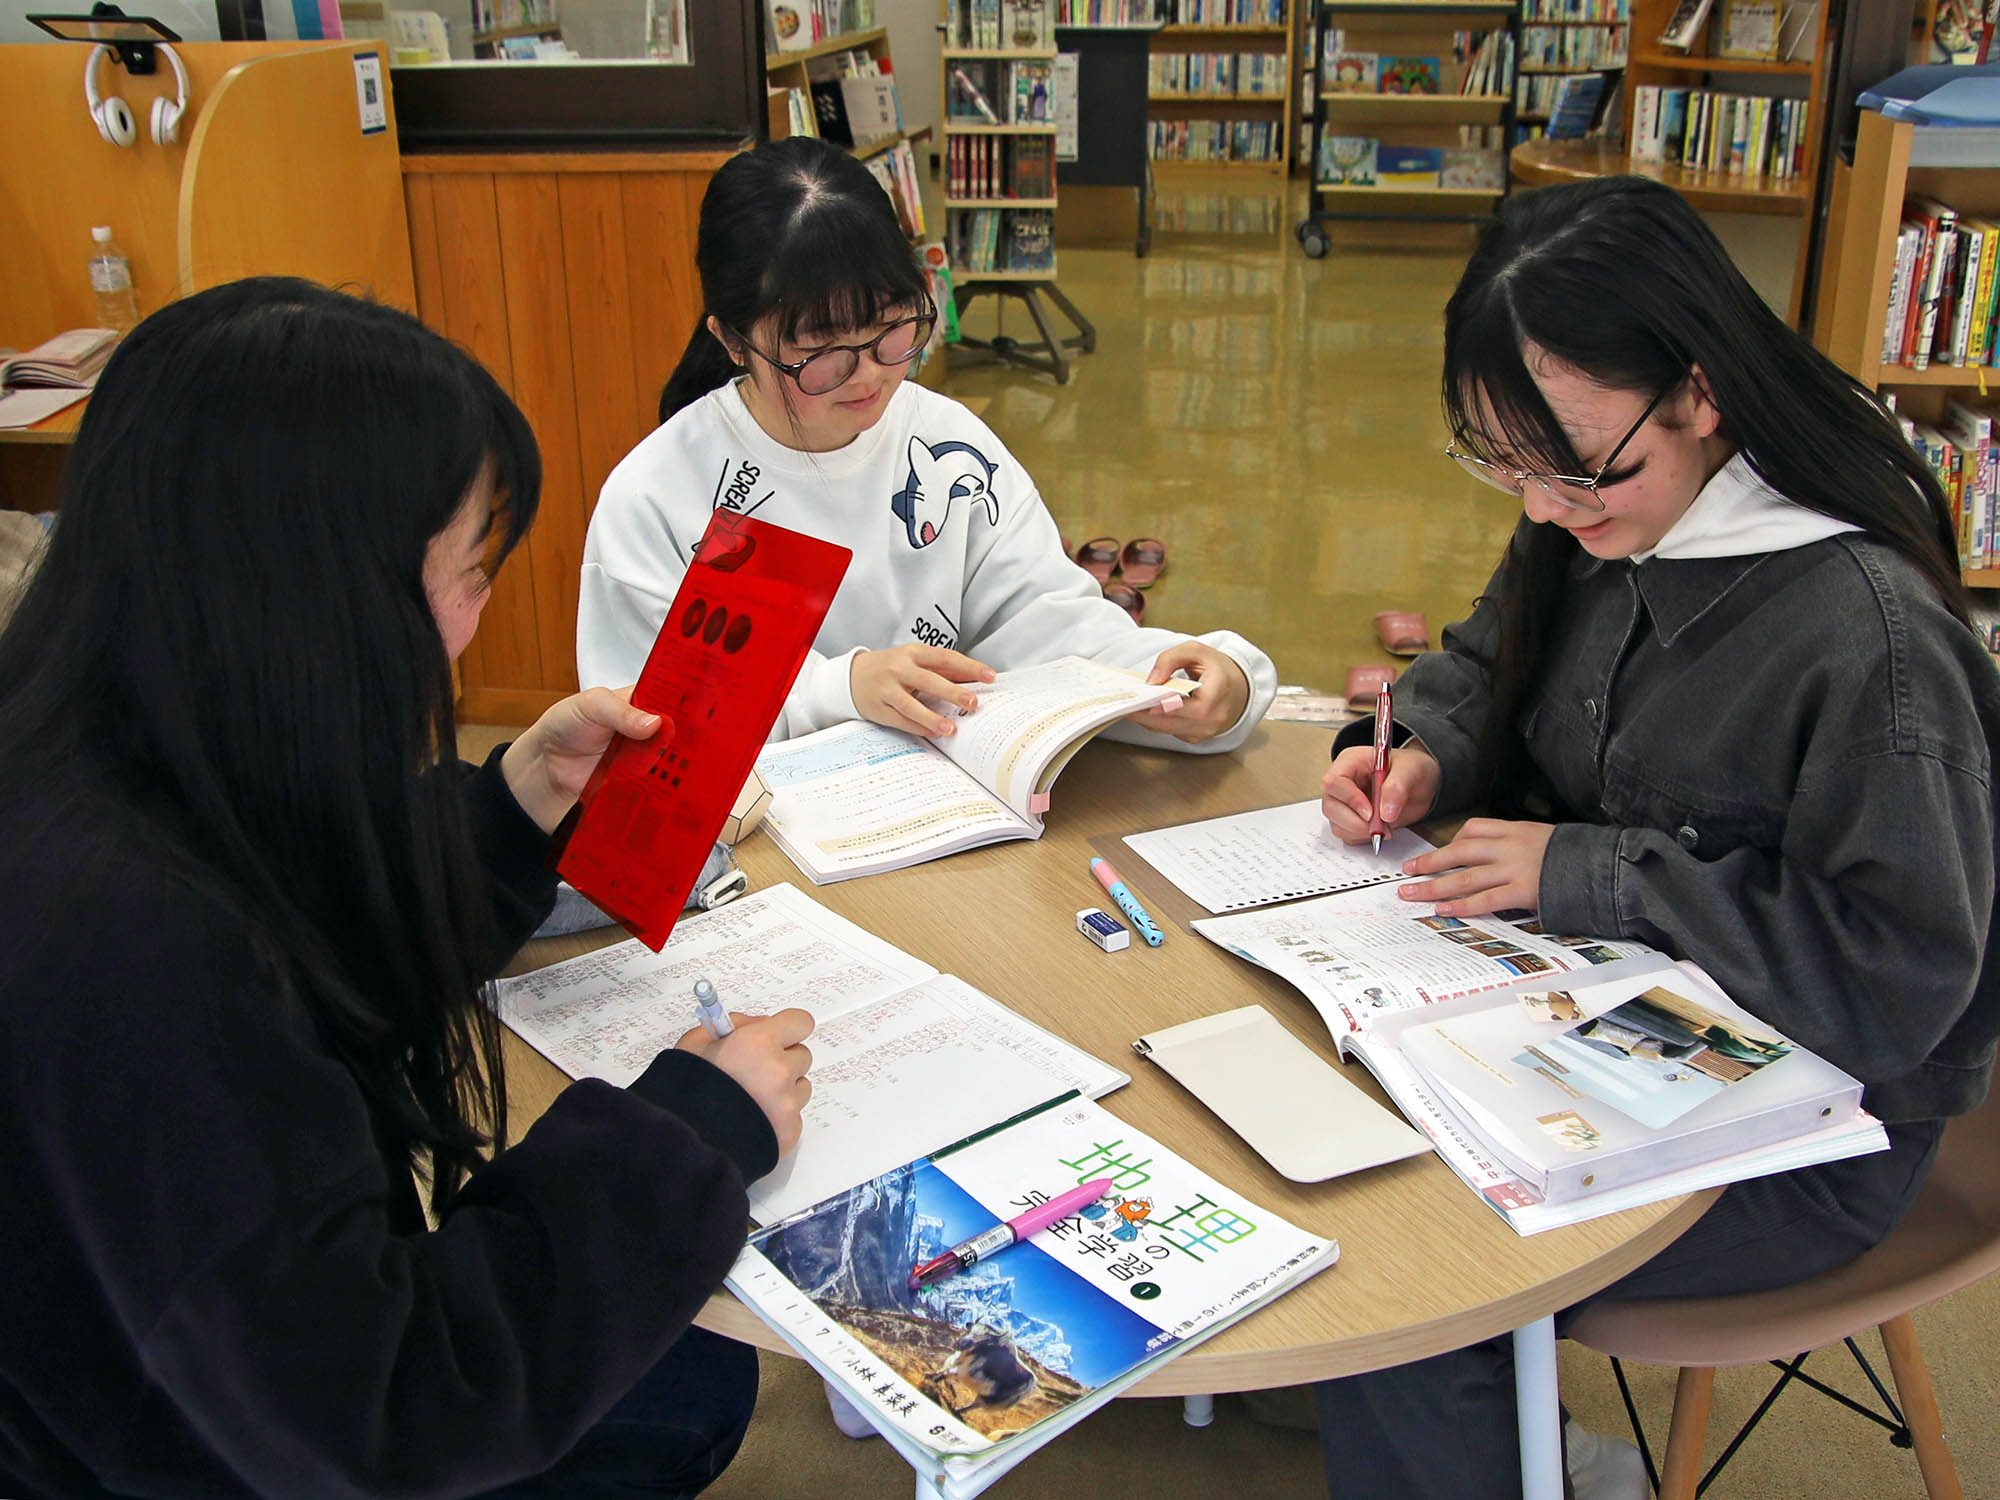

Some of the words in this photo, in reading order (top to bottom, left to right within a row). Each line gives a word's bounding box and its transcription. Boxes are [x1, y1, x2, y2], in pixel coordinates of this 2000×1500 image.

[911, 617, 958, 651] SCREA
[1057, 1139, 1257, 1263] 地理
[1009, 1190, 1154, 1281] 完全学習
[1144, 1245, 1170, 1260] の
